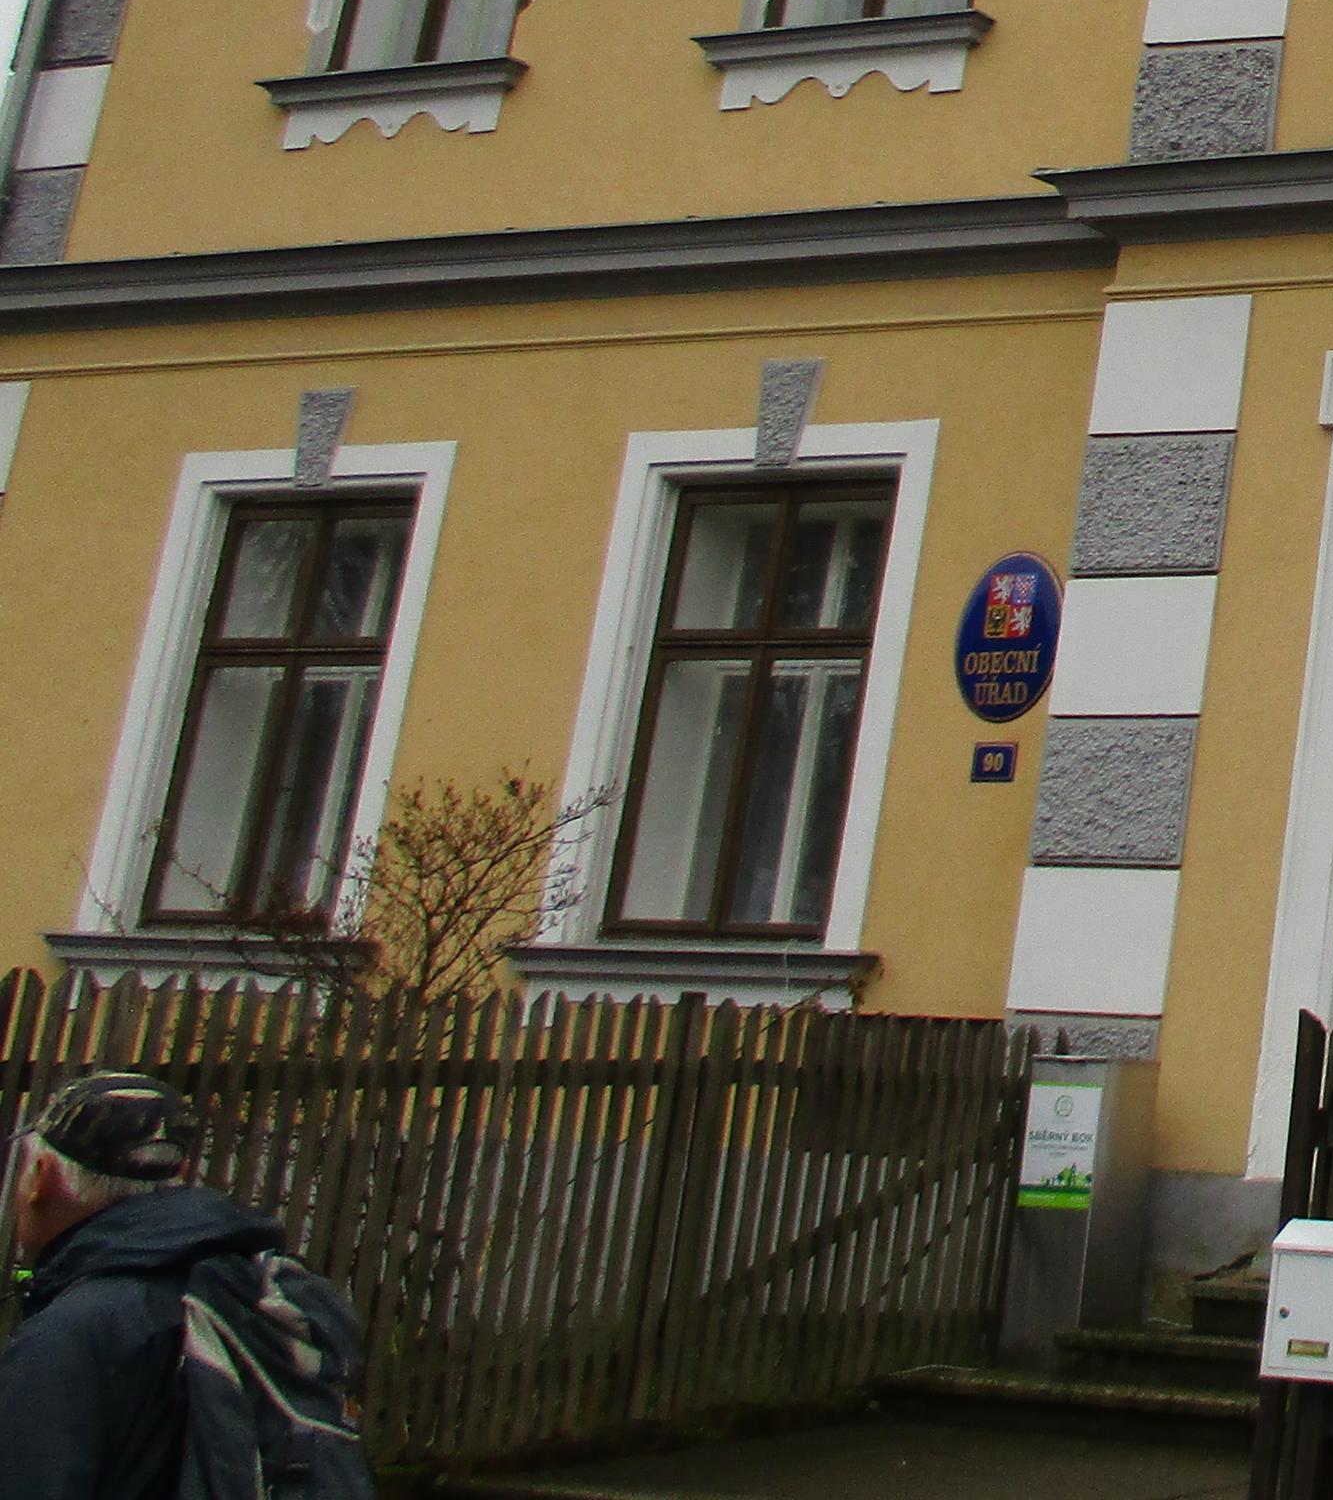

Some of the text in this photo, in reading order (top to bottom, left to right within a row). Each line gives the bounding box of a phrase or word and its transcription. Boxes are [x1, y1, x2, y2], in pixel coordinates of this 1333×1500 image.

[964, 642, 1042, 675] OBECNÍ
[974, 674, 1029, 706] ÚŘAD
[983, 752, 1005, 772] 90
